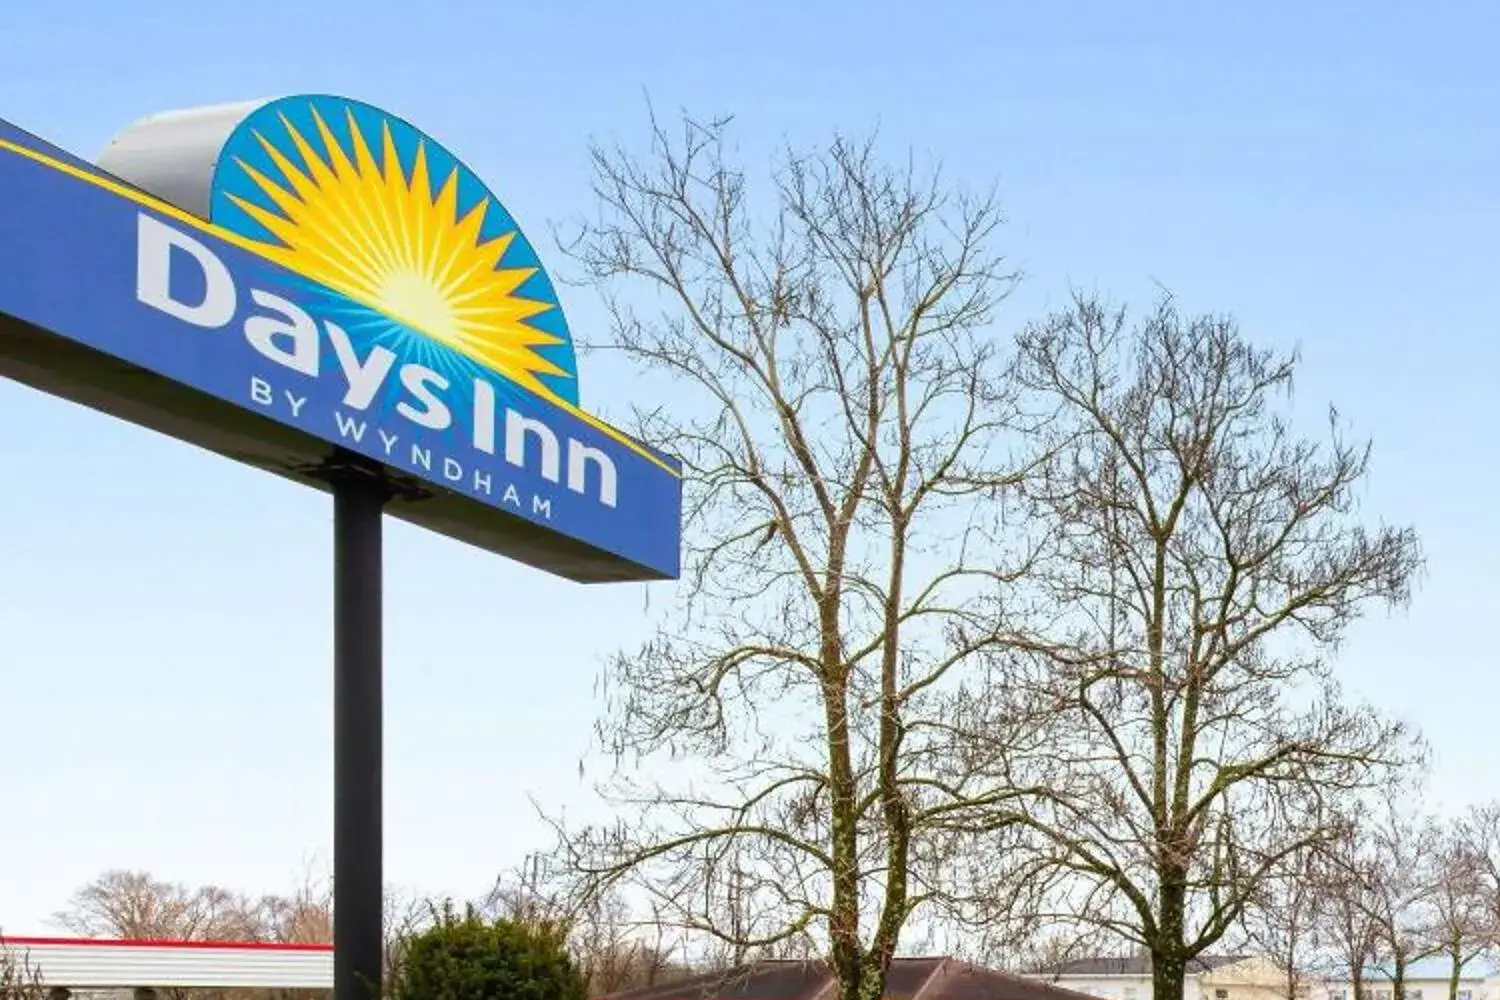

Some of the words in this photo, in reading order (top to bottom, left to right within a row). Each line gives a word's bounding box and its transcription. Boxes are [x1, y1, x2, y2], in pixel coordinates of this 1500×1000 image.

[136, 212, 452, 431] Days
[472, 377, 618, 508] Inn
[250, 376, 306, 417] BY
[335, 411, 551, 519] WYNDHAM
